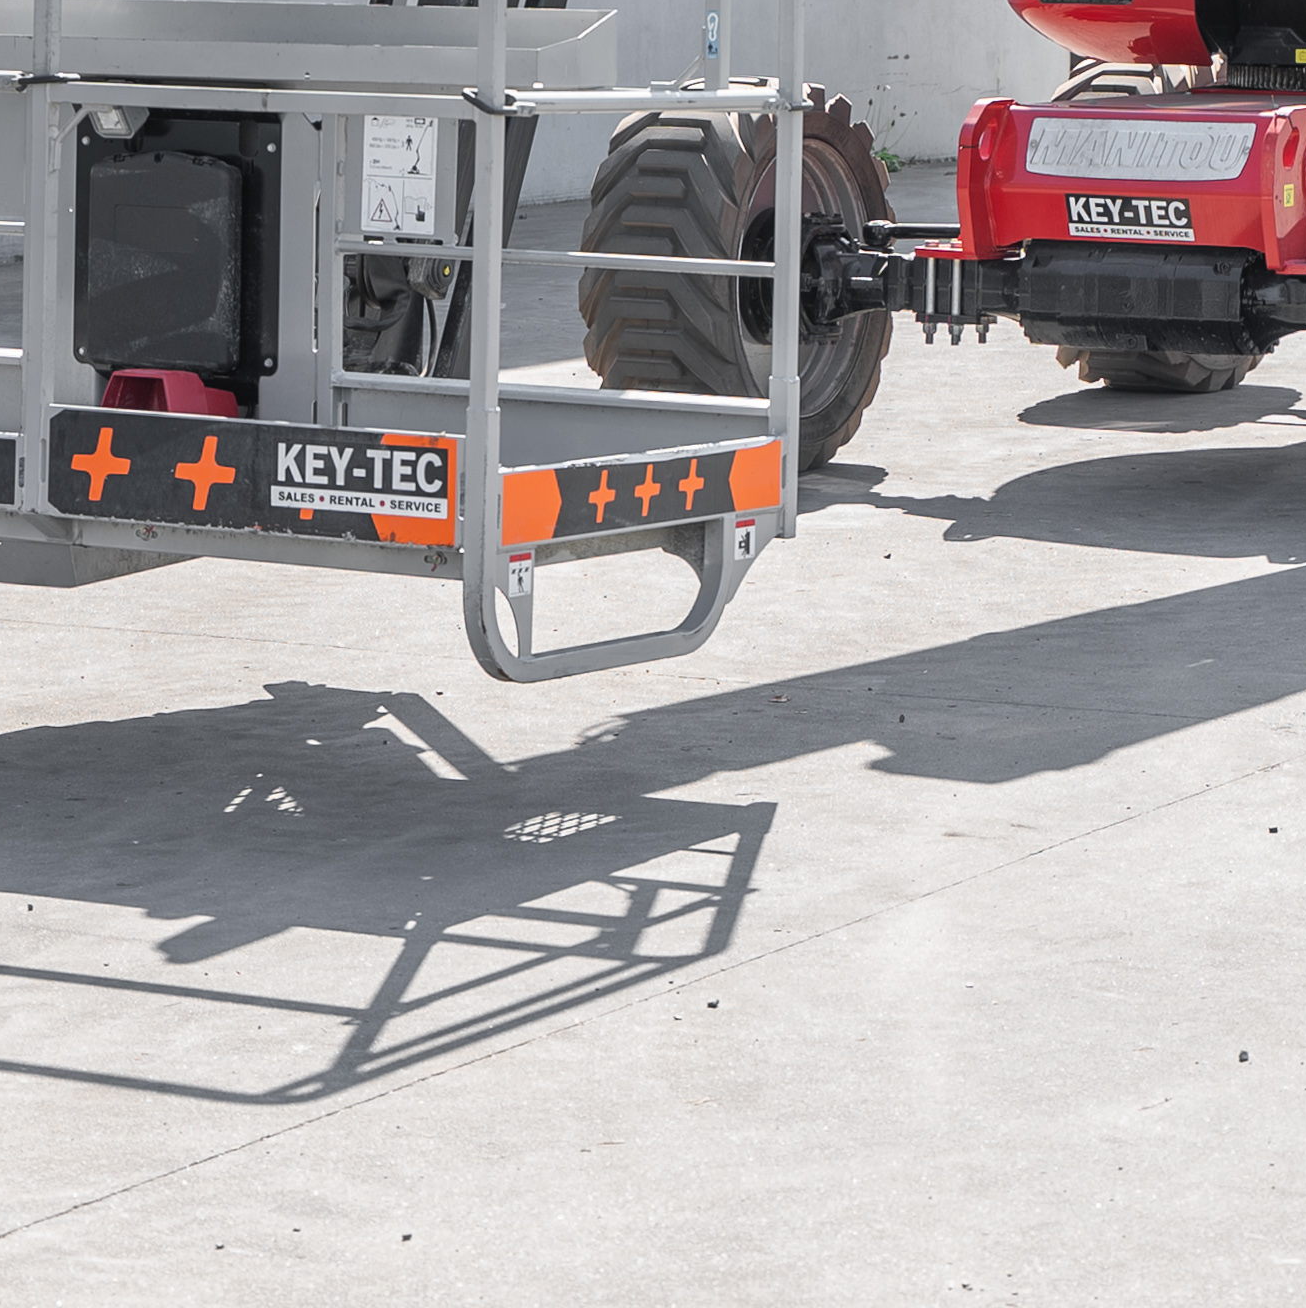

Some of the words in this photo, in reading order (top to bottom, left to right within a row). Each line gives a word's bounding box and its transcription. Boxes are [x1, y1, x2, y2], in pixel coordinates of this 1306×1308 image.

[1030, 128, 1250, 172] MANITOU
[1068, 196, 1189, 227] KEY-TEC
[1074, 225, 1101, 234] SALES
[1110, 227, 1144, 236] RENTAL
[1153, 229, 1190, 238] SERVICE
[277, 442, 444, 494] KEY-TEC
[278, 491, 316, 504] SALES
[329, 495, 376, 508] RENTAL
[389, 499, 442, 513] SERVICE
